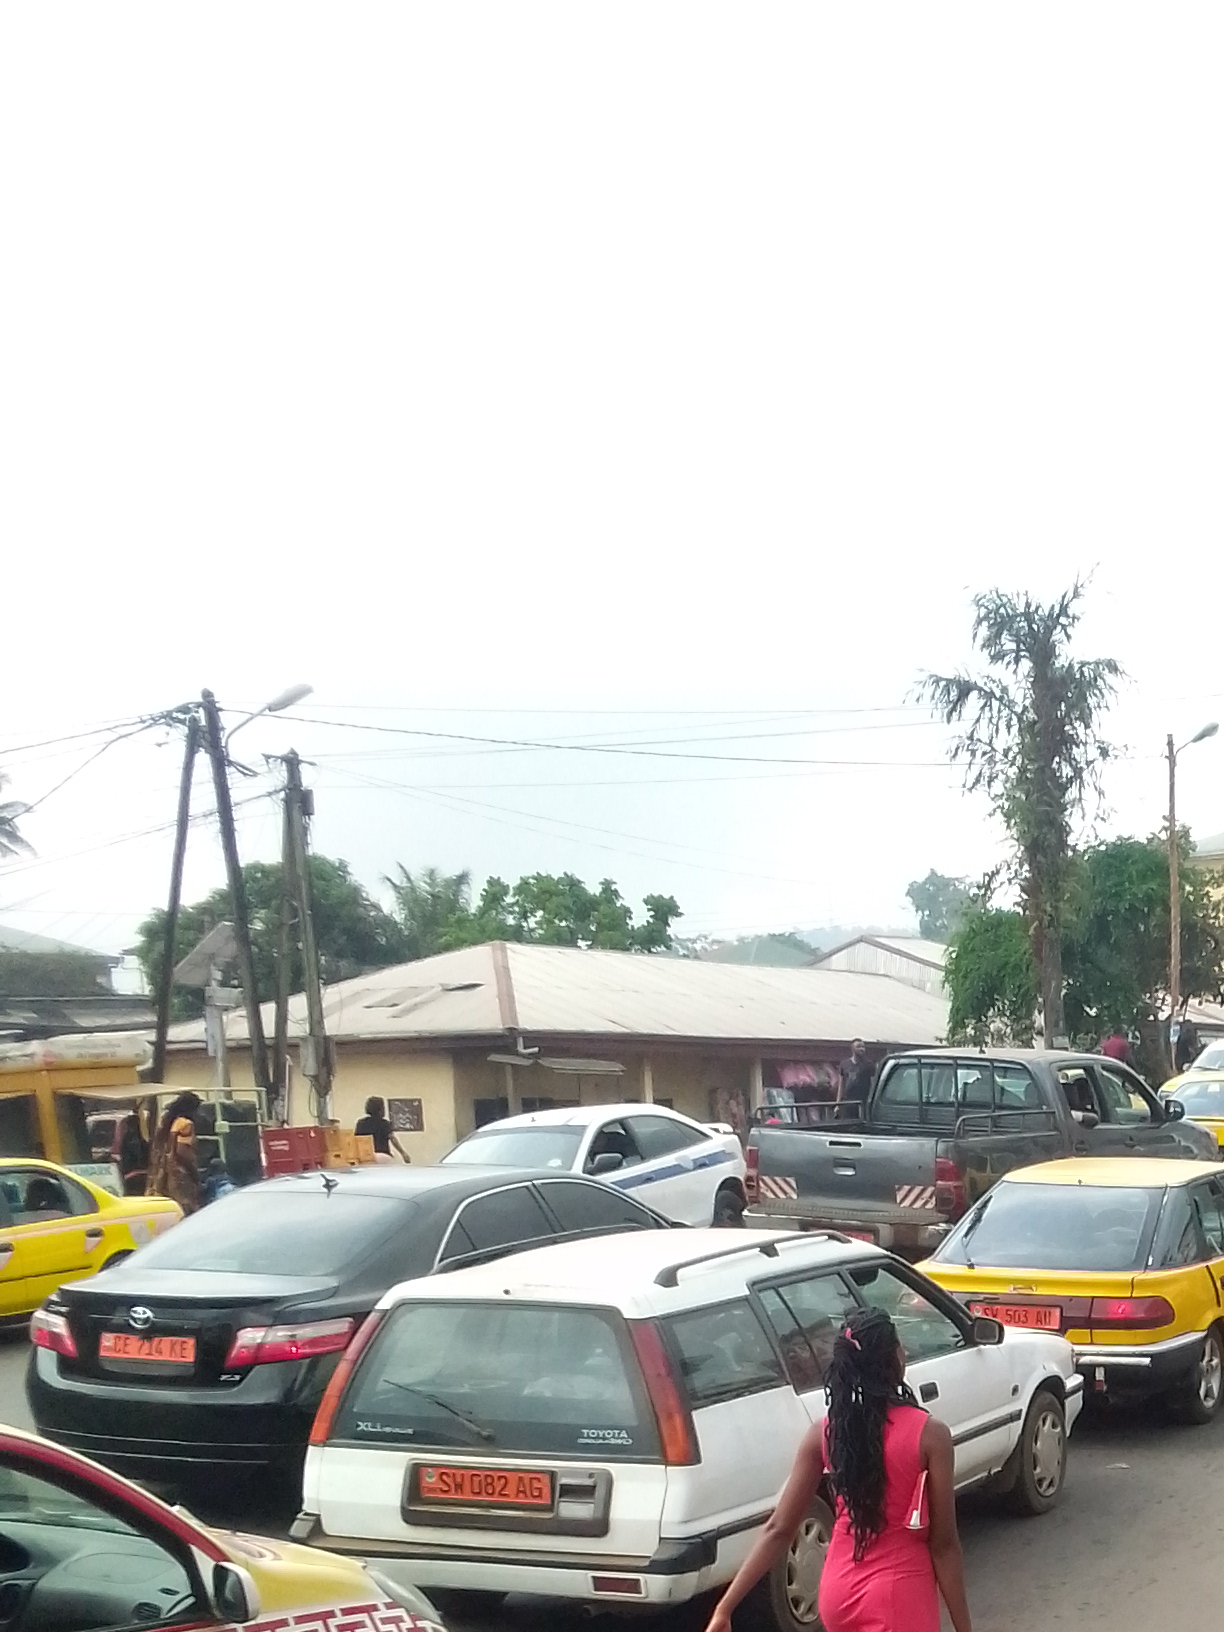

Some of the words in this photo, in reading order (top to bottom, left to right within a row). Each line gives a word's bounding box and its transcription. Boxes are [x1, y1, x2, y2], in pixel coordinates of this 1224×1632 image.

[1005, 1309, 1029, 1324] 503
[113, 1335, 130, 1355] CE
[580, 1429, 629, 1439] TOYOTA
[439, 1471, 465, 1495] SW
[470, 1473, 510, 1498] 082
[516, 1476, 544, 1500] AG
